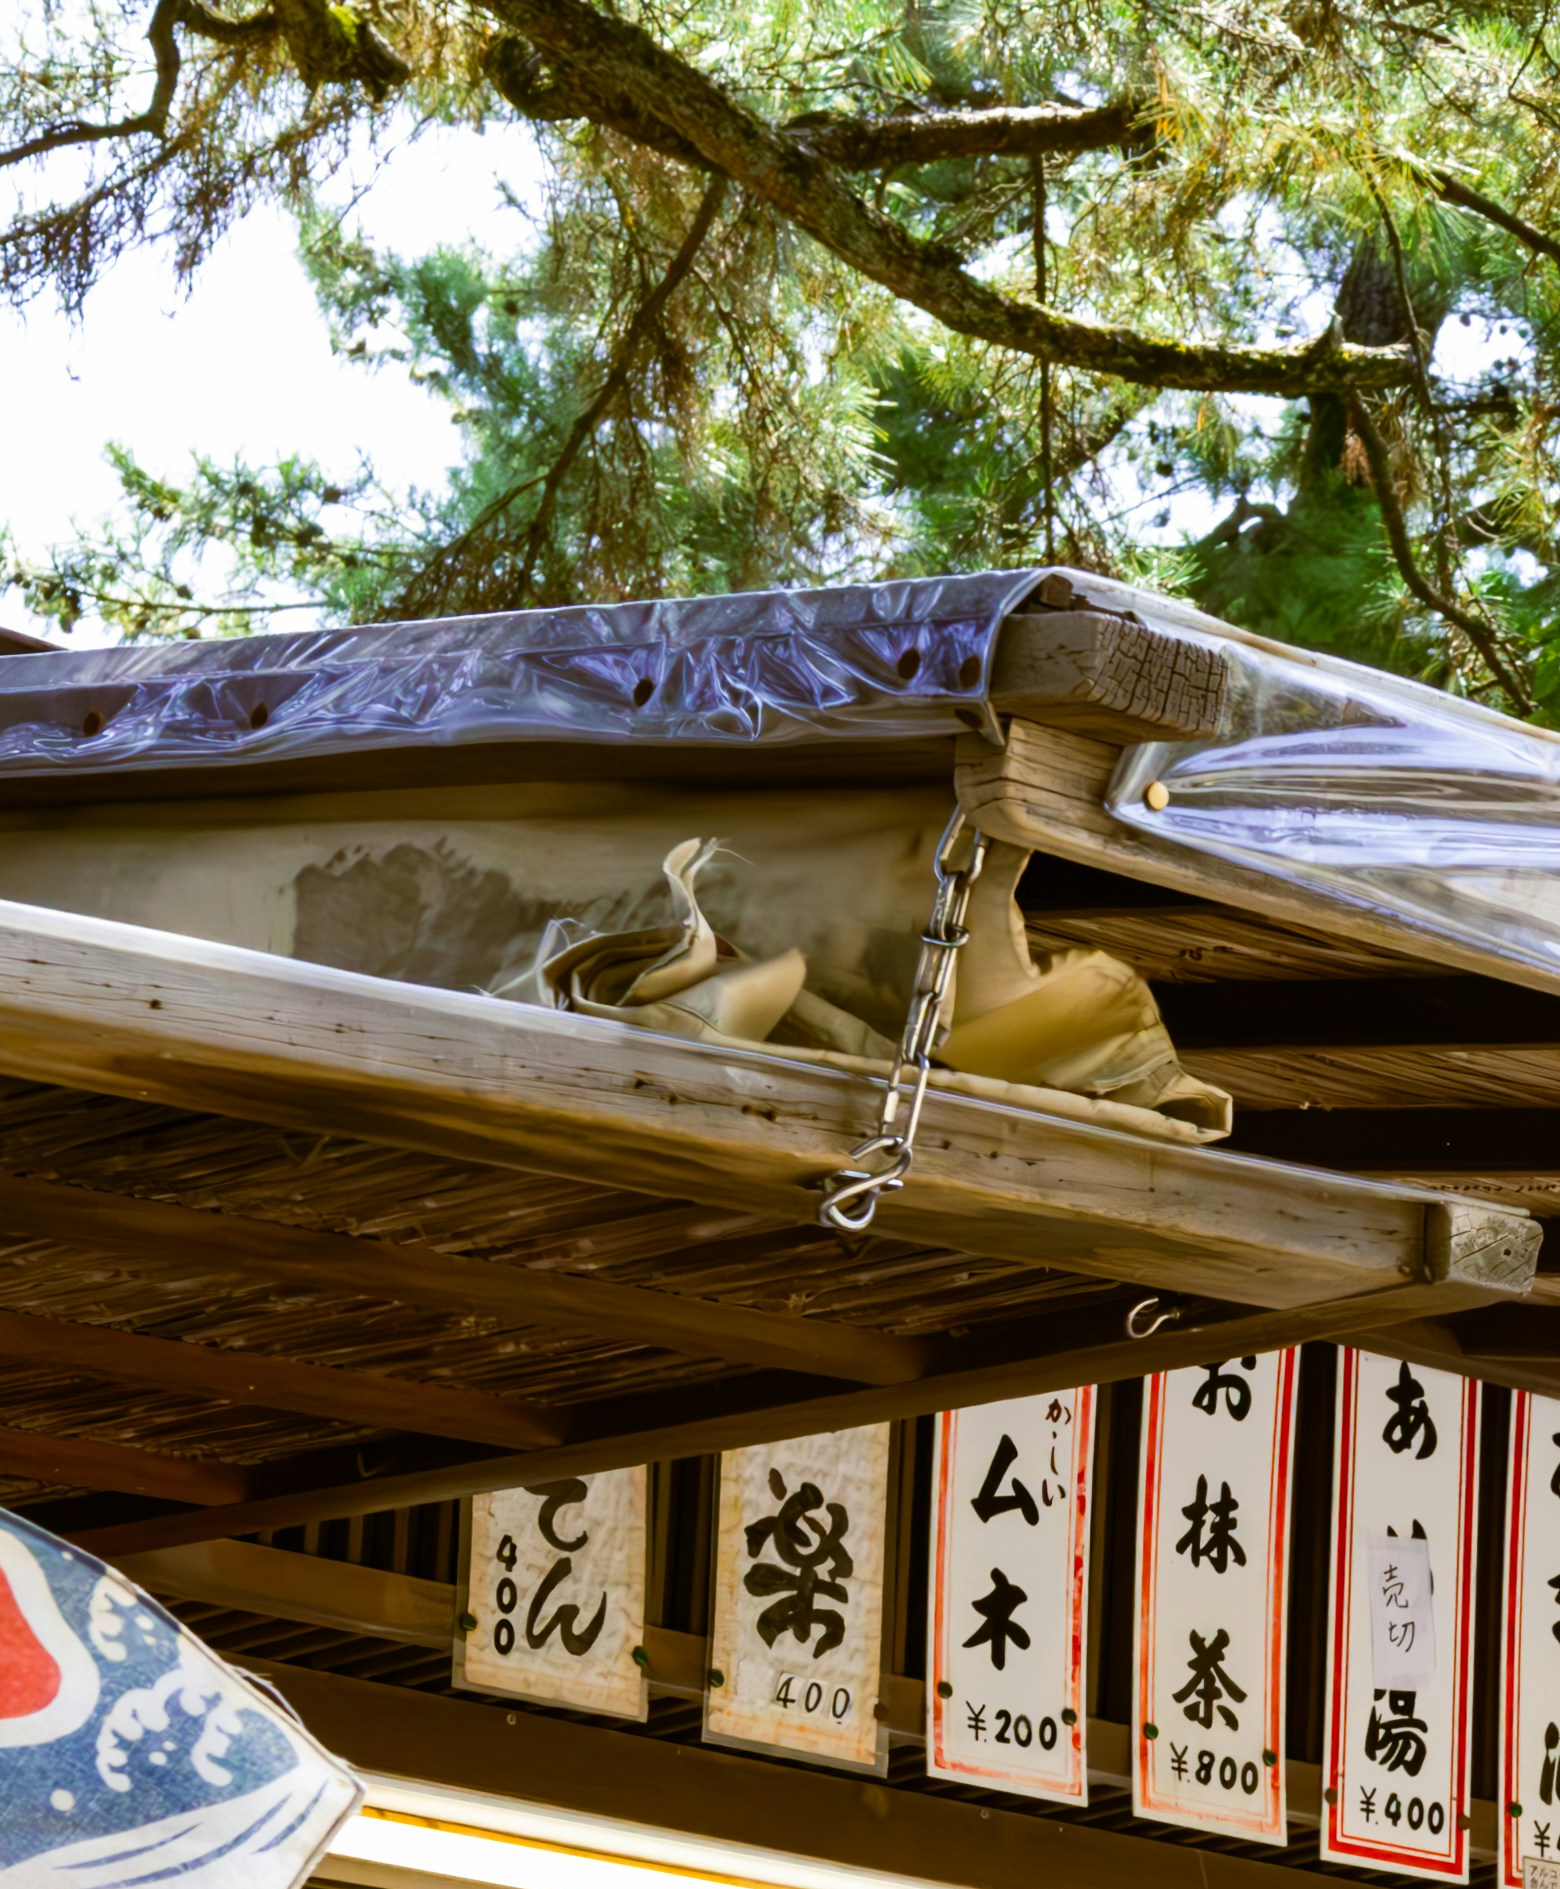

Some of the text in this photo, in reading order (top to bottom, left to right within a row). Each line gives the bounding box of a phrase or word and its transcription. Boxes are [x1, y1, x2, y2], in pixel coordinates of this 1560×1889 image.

[494, 1535, 517, 1655] 400
[1365, 1360, 1437, 1778] あ湯
[1382, 1563, 1415, 1654] 売切
[773, 1672, 852, 1722] 400
